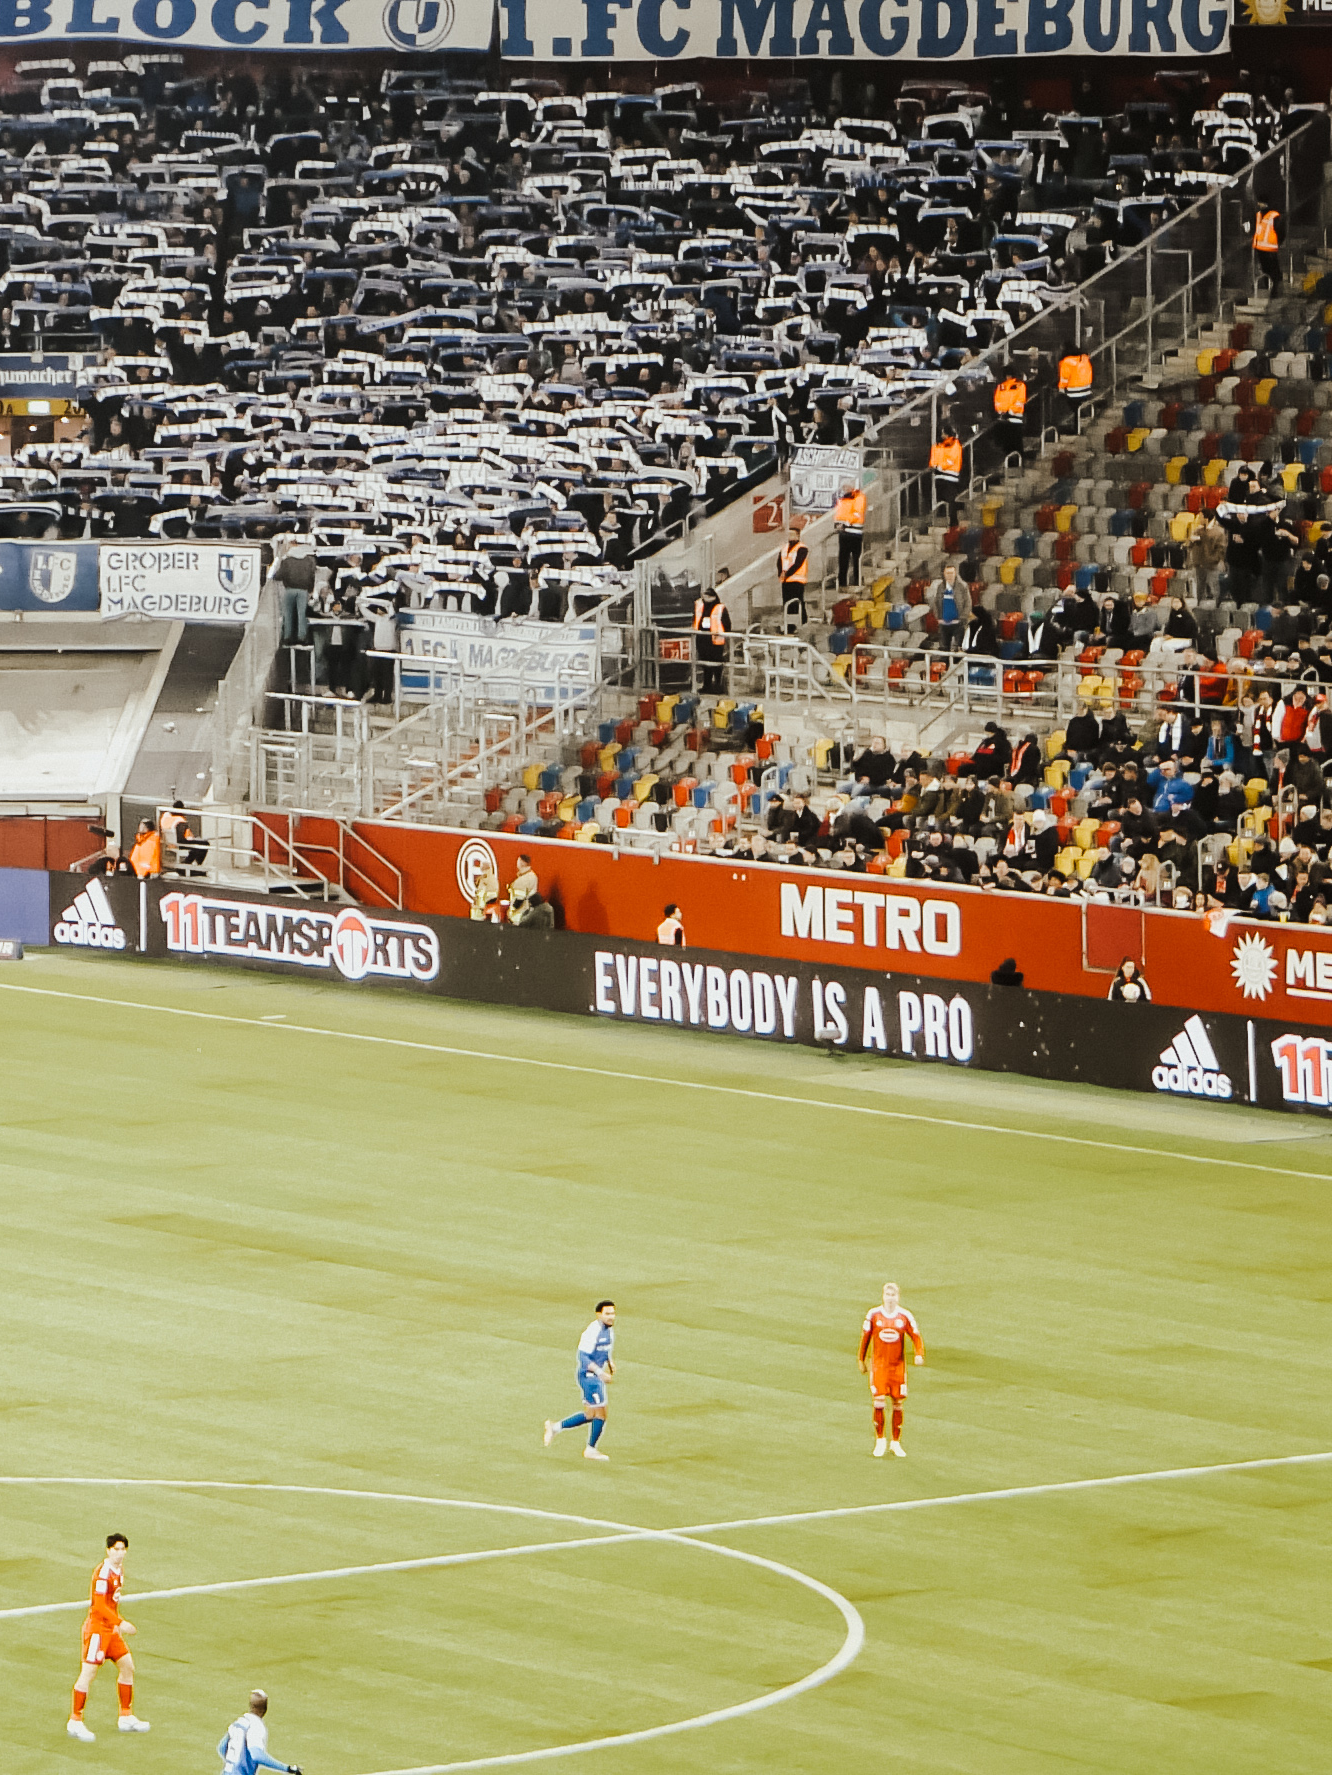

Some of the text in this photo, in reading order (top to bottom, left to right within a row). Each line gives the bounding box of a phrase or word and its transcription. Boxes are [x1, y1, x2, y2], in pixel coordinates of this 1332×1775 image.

[107, 594, 250, 615] MAGDEBURG
[54, 920, 126, 950] adidas
[779, 882, 962, 957] METRO
[594, 950, 974, 1062] EVERYBODY IS A PRO
[1151, 1063, 1233, 1100] adidas
